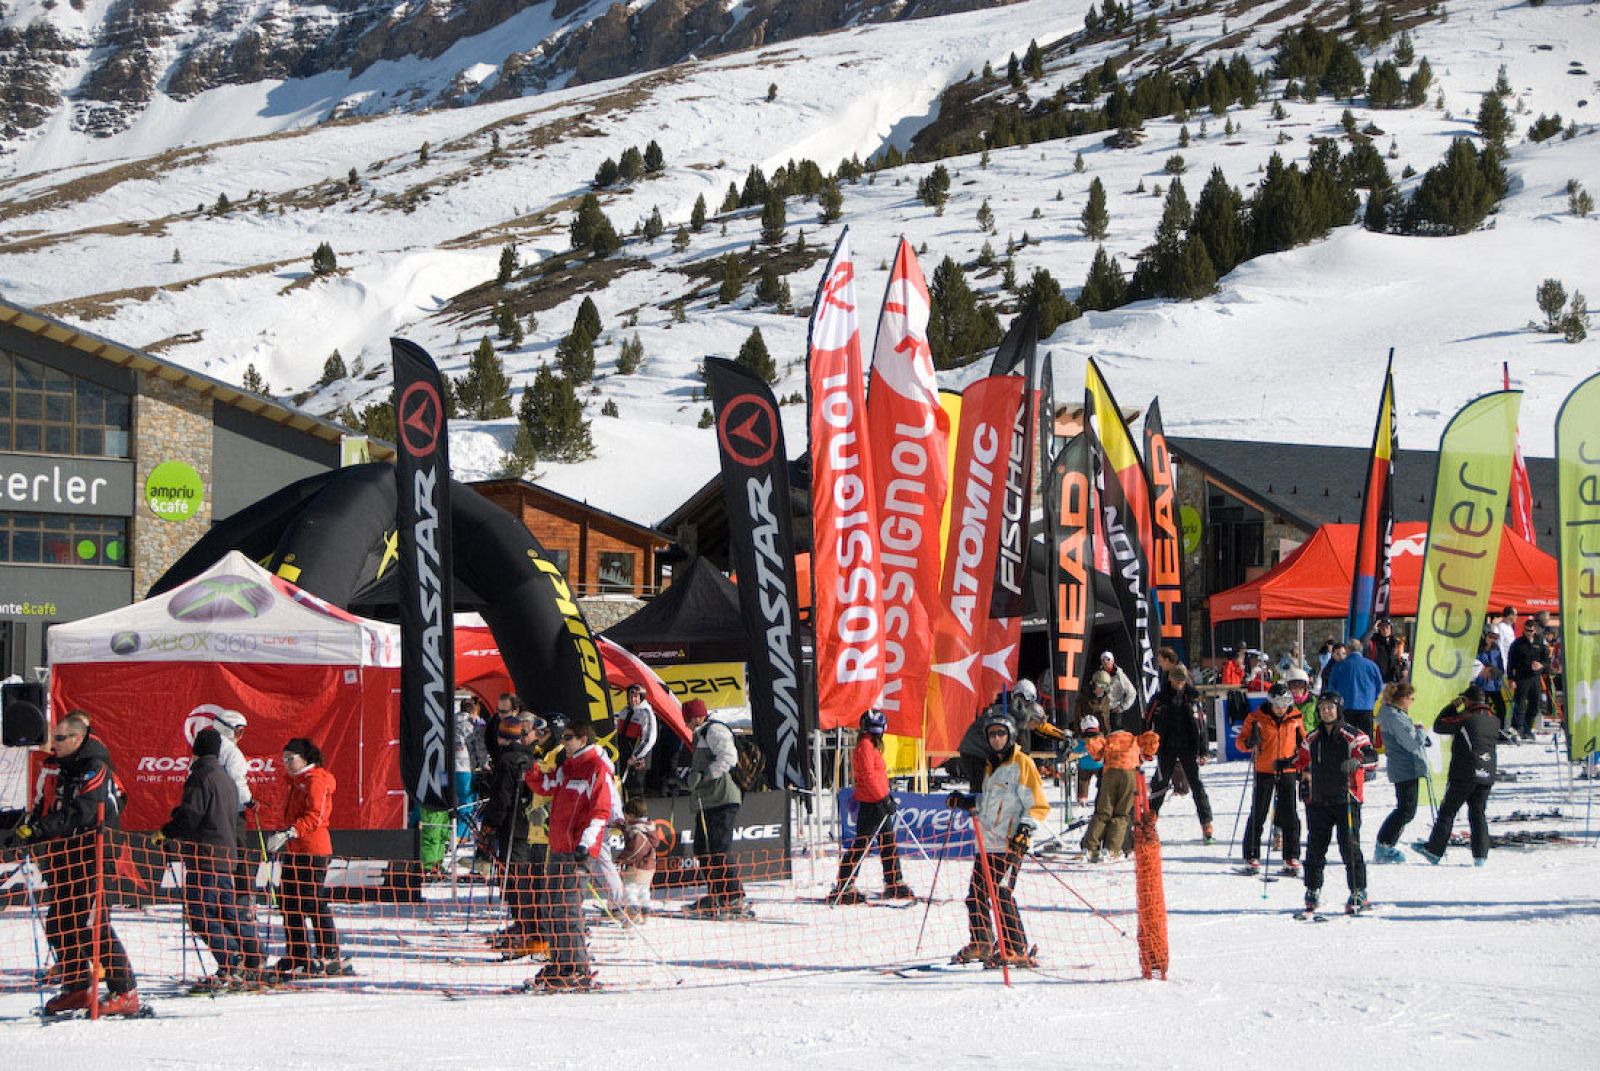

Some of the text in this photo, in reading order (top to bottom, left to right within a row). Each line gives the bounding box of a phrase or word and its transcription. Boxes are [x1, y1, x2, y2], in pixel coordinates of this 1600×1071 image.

[0, 466, 107, 505] erler
[150, 485, 194, 501] ampriu
[151, 498, 189, 514] &café
[821, 353, 879, 685] ROSSIGNOL
[950, 422, 999, 638] ATOMIC
[1058, 471, 1088, 692] HEAD
[1151, 432, 1182, 638] HEAD
[1426, 460, 1498, 679] cerler
[0, 601, 57, 615] nte&café
[149, 632, 208, 651] XBOX
[214, 632, 257, 652] 360
[413, 463, 446, 802] DYNASTAR
[747, 473, 806, 790] DYNASTAR
[681, 823, 782, 845] LNGE
